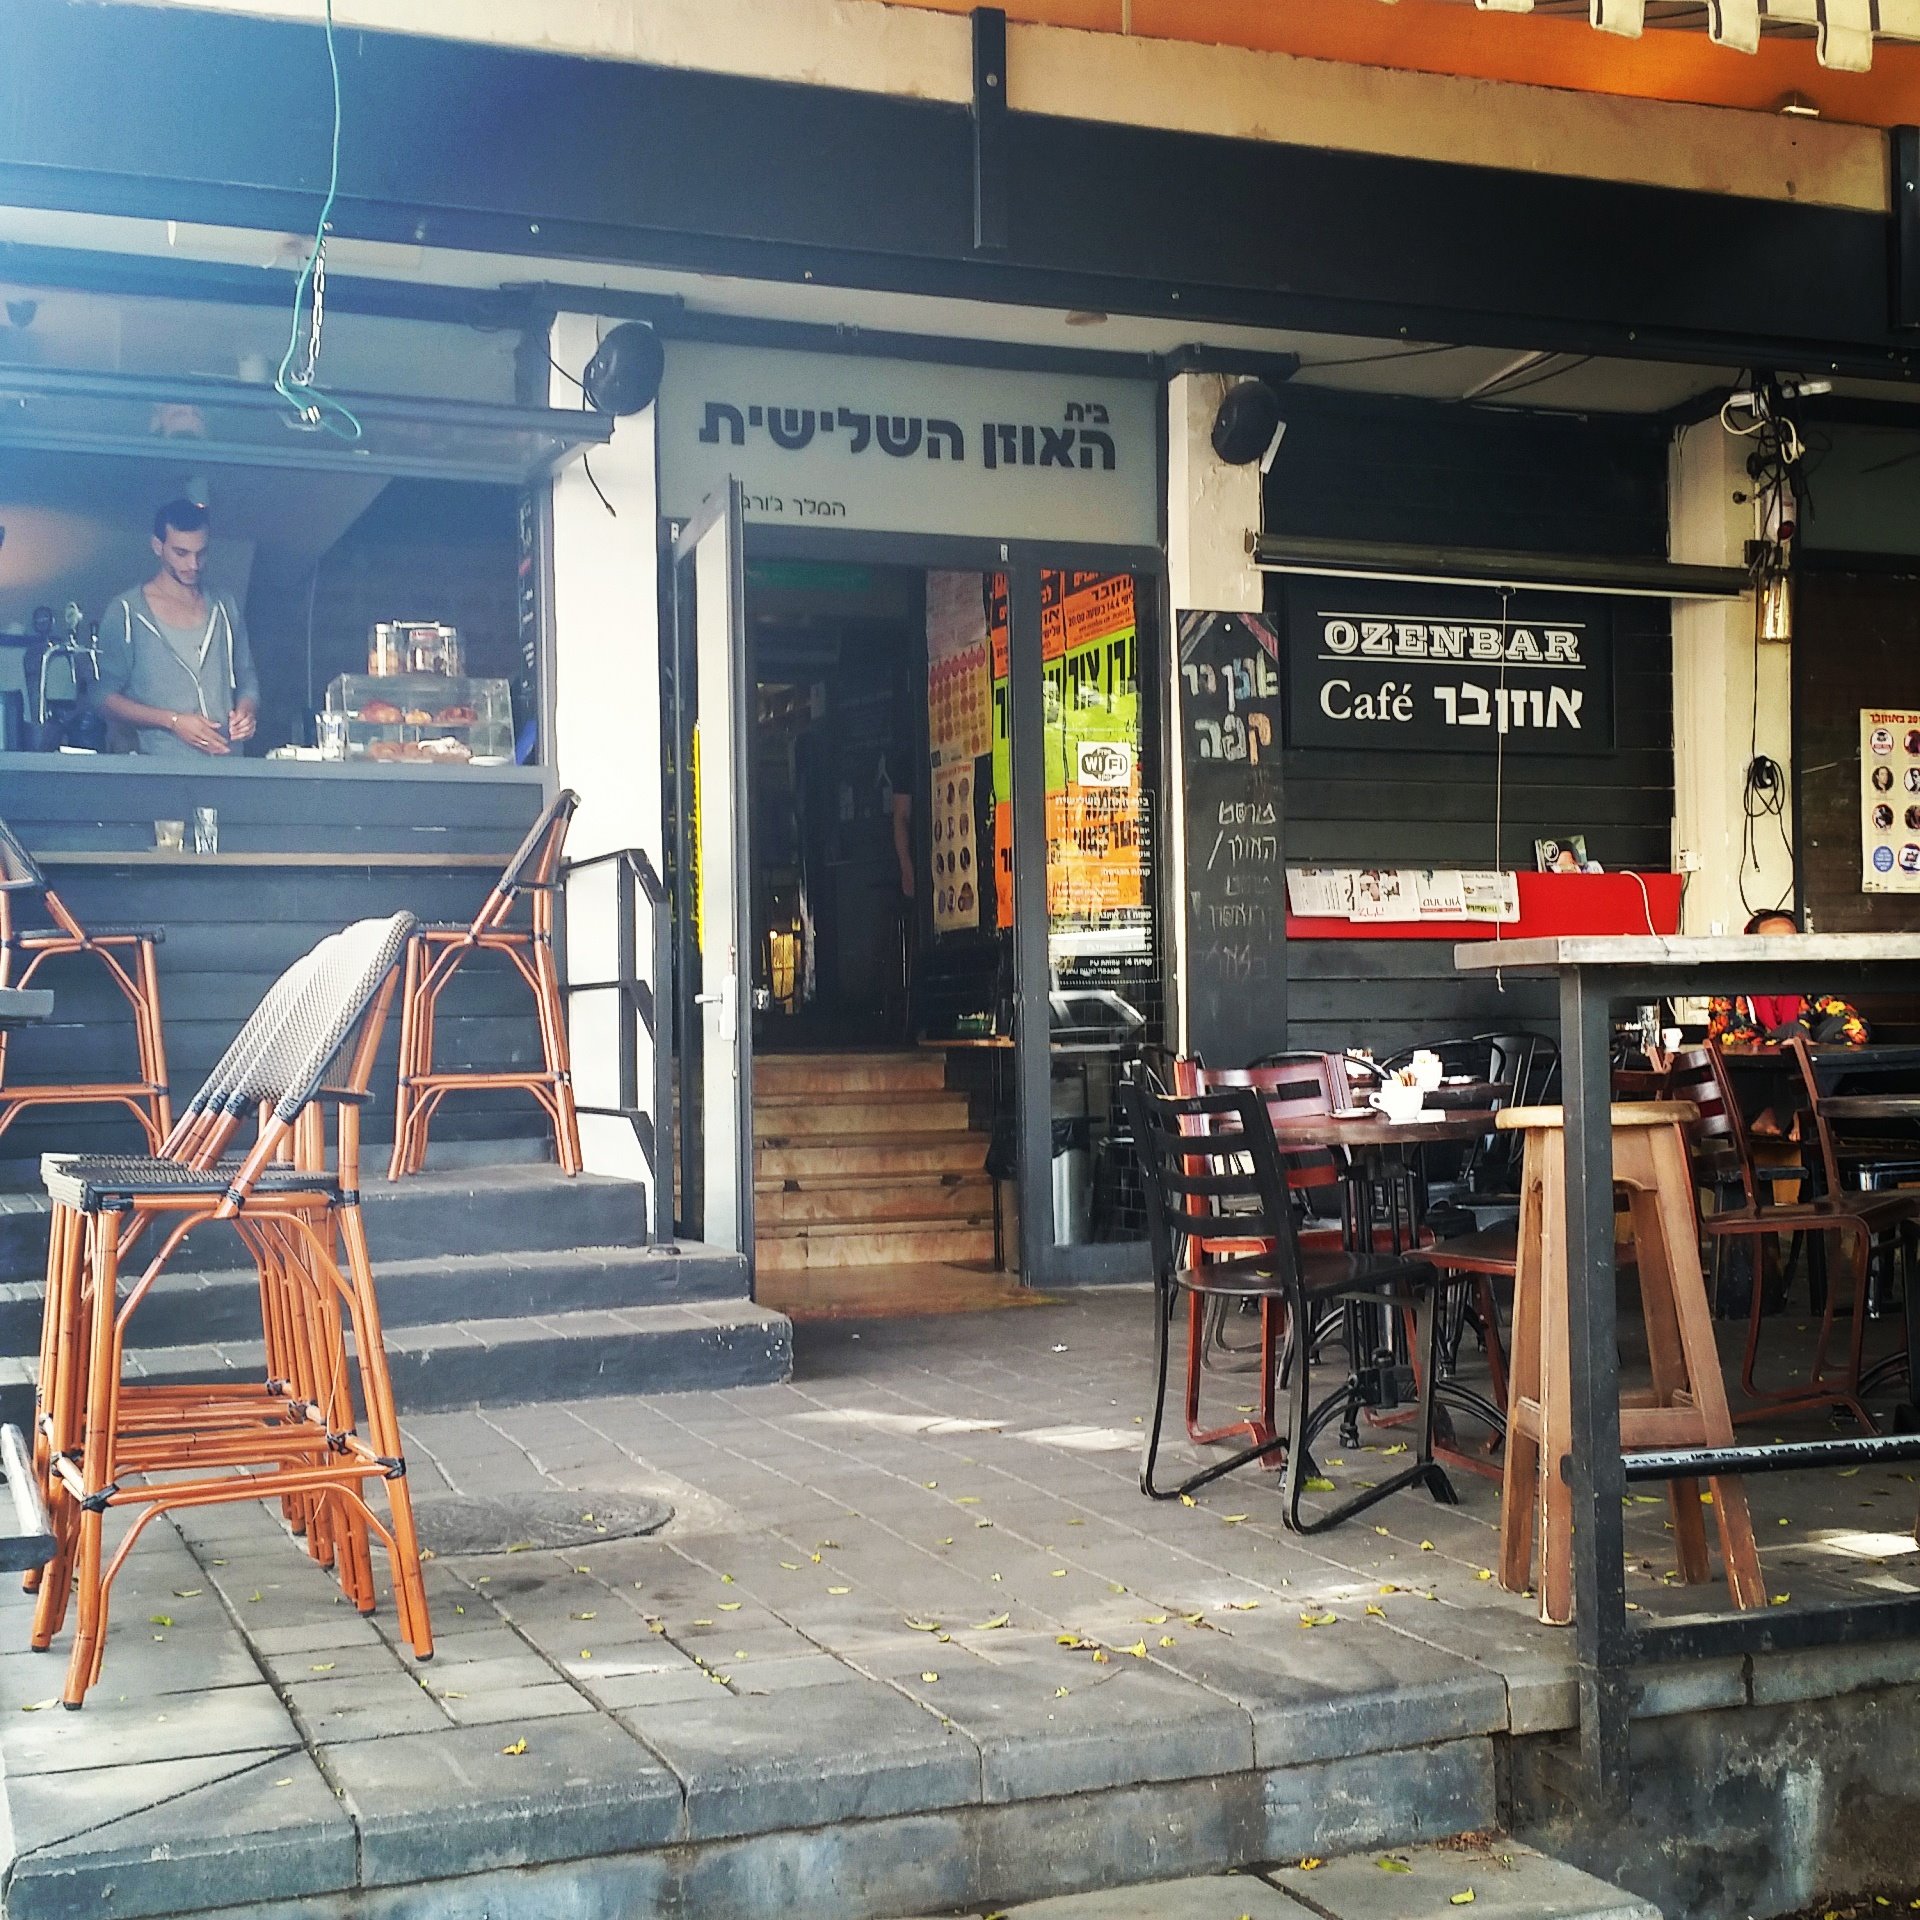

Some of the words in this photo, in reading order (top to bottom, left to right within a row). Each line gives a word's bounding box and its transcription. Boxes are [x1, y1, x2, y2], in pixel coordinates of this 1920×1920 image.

[698, 400, 965, 461] השלישית
[1064, 401, 1110, 425] בית
[982, 422, 1117, 471] האוזן
[792, 497, 846, 516] המלך
[1324, 619, 1581, 663] OZENBAR
[1319, 678, 1414, 723] Café
[1194, 712, 1272, 767] קפה
